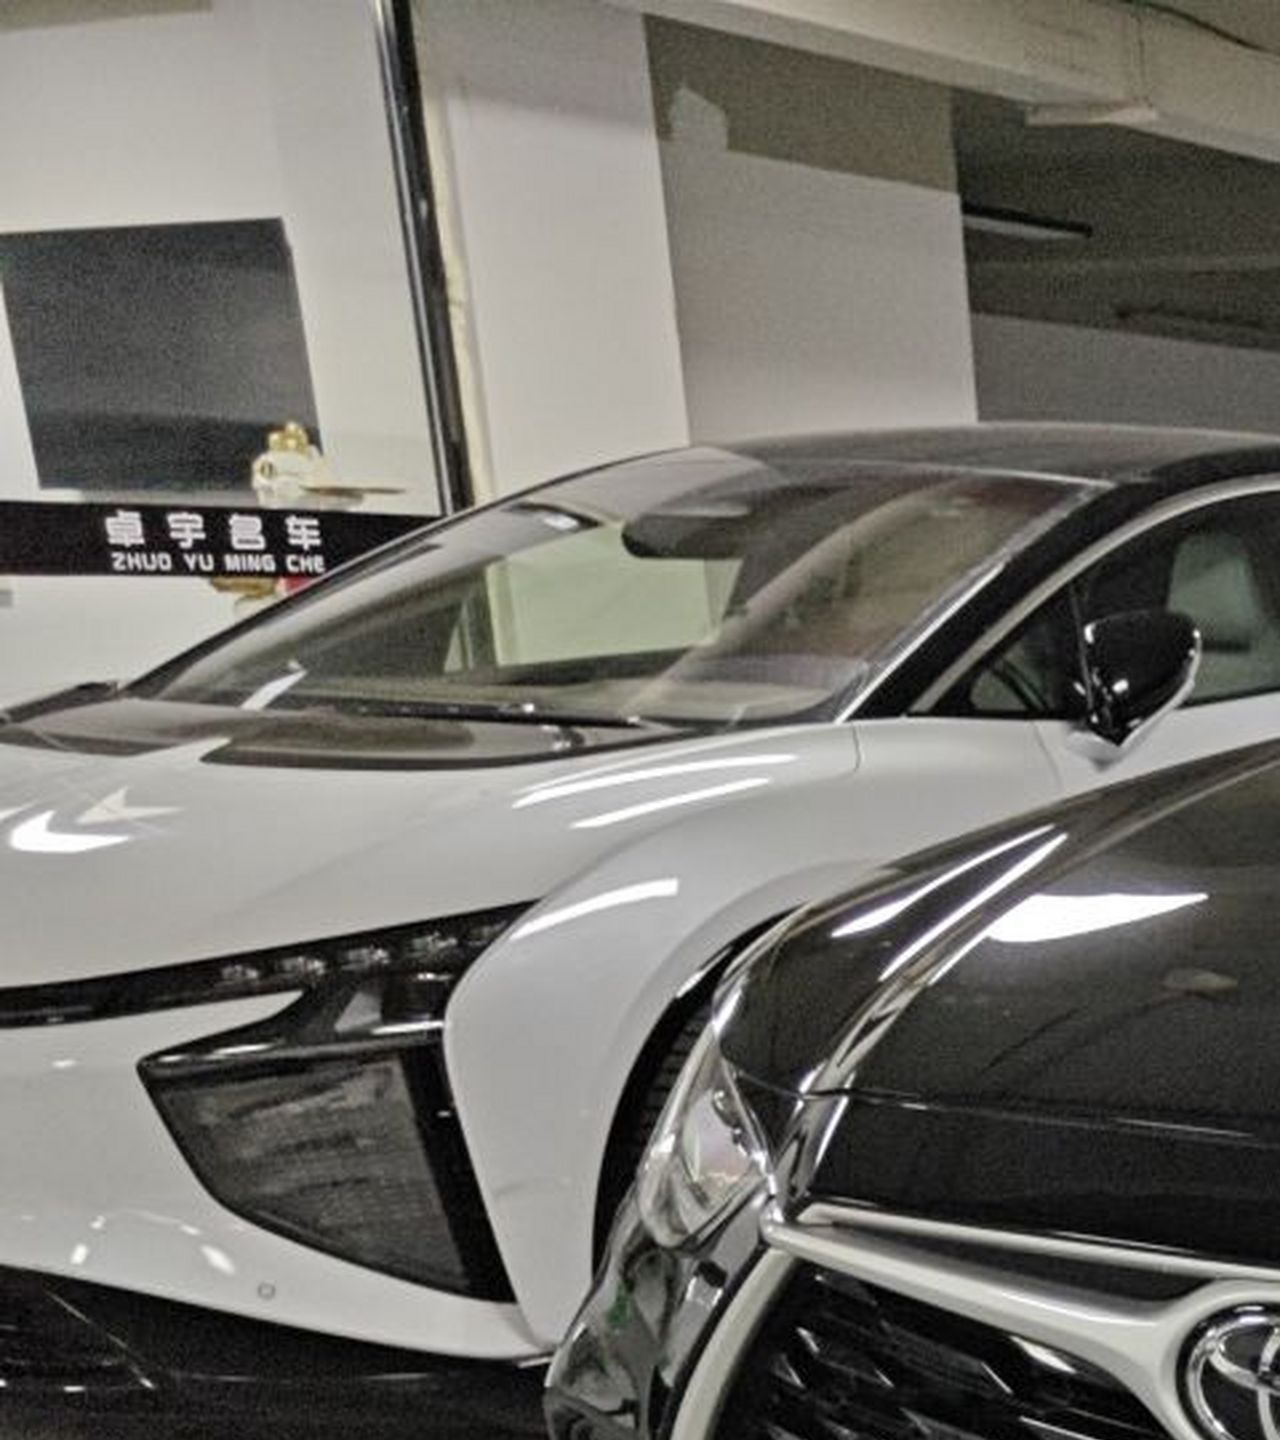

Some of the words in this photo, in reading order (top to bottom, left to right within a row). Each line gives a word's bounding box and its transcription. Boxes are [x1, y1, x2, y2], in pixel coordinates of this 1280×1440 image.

[112, 553, 172, 571] ZHUO
[184, 553, 215, 571] YU
[225, 554, 276, 572] MING
